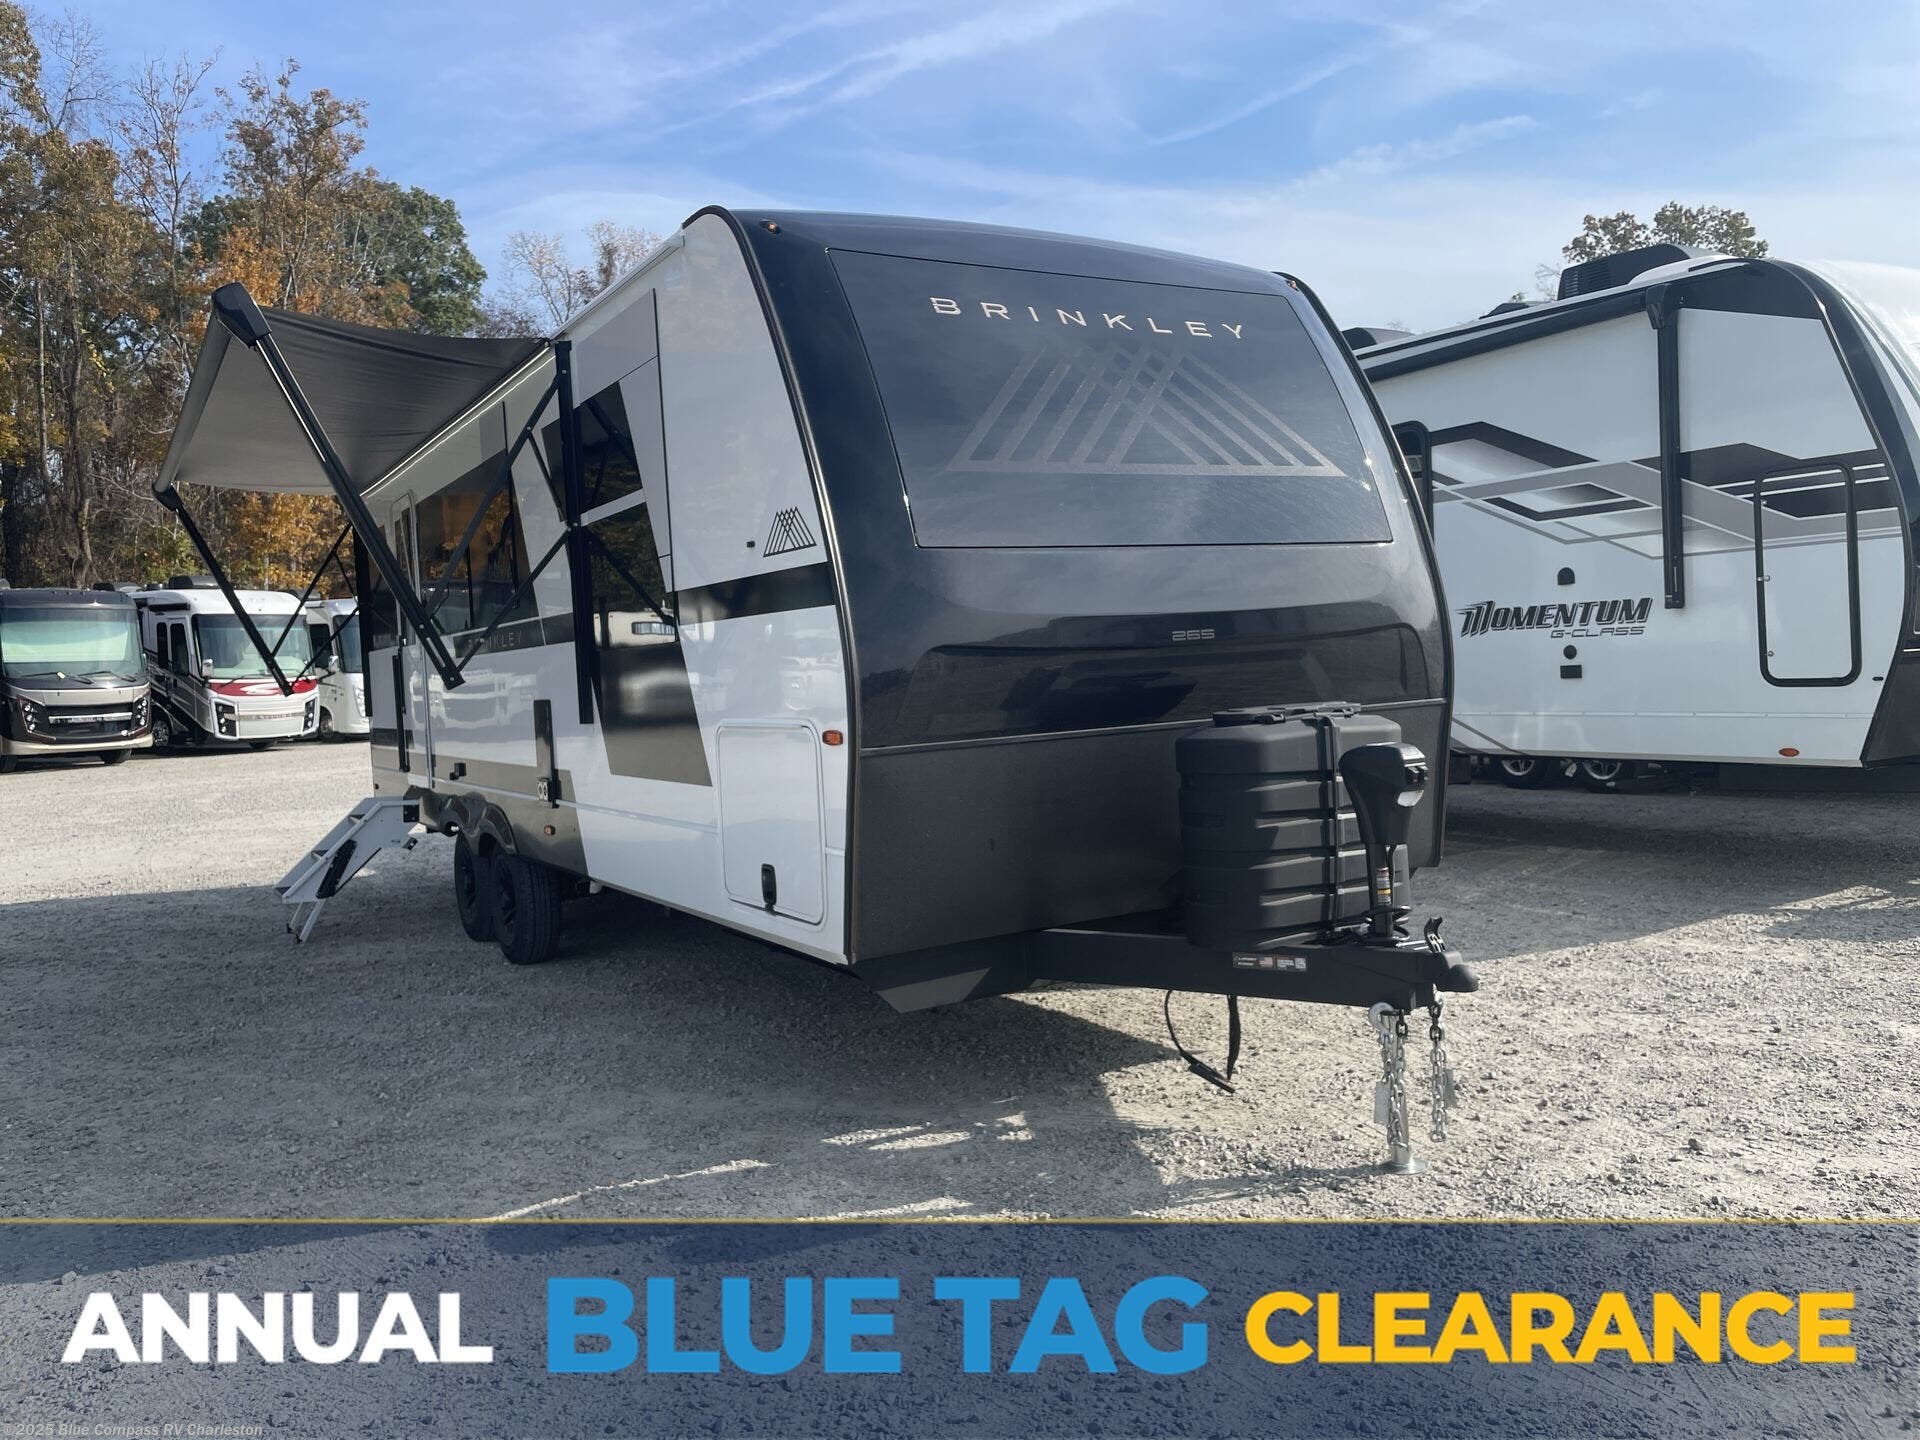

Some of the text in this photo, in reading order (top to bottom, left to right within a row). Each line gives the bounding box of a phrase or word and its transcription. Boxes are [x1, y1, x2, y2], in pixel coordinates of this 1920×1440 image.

[929, 297, 1243, 340] BRINKLEY
[1455, 597, 1653, 637] MOMENTUM
[467, 630, 523, 650] BNKLEY
[1171, 628, 1215, 641] 265
[1550, 626, 1645, 639] G-CLASS
